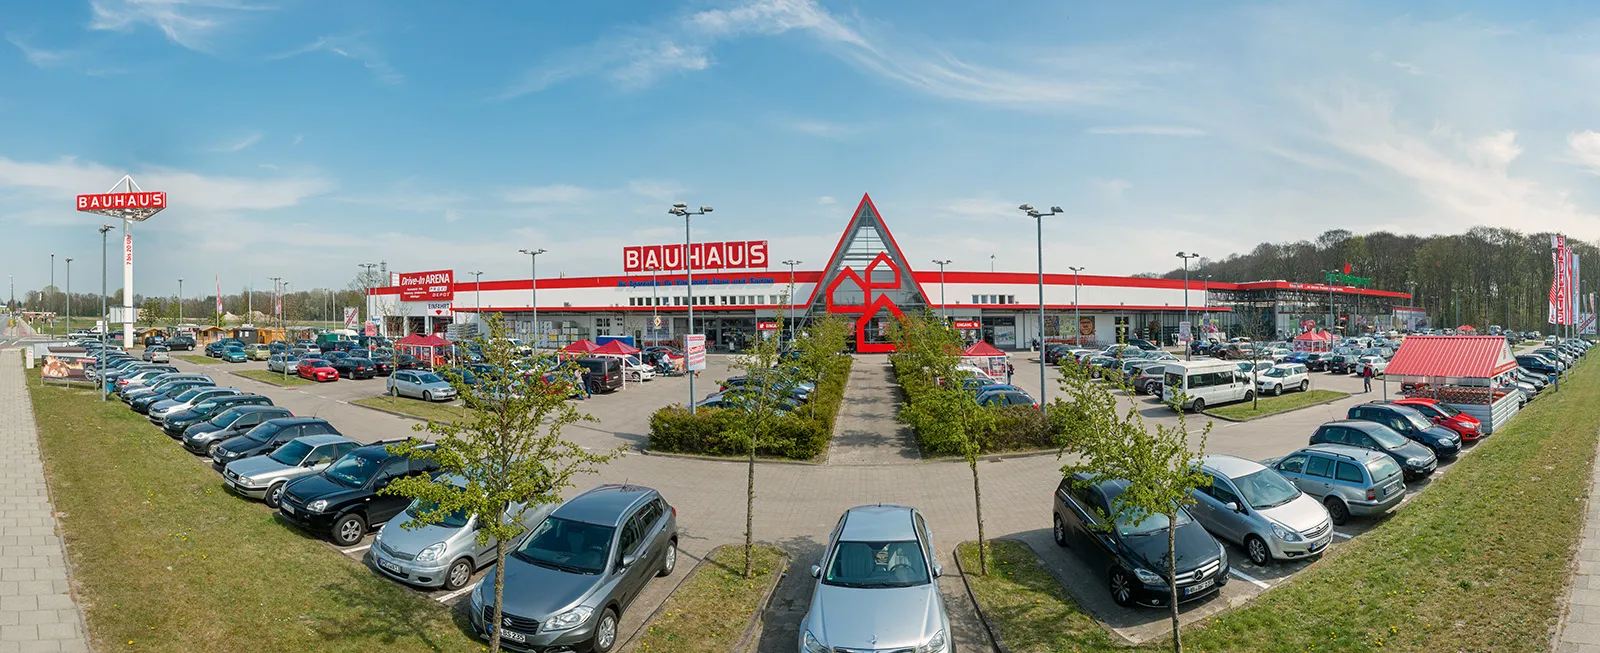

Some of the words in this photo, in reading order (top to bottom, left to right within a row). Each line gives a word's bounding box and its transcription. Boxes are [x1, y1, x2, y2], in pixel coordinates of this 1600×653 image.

[78, 194, 163, 208] BAUHAUS
[625, 244, 766, 269] BAUHAUS
[401, 276, 425, 286] Drive-In
[425, 273, 450, 284] ARENA
